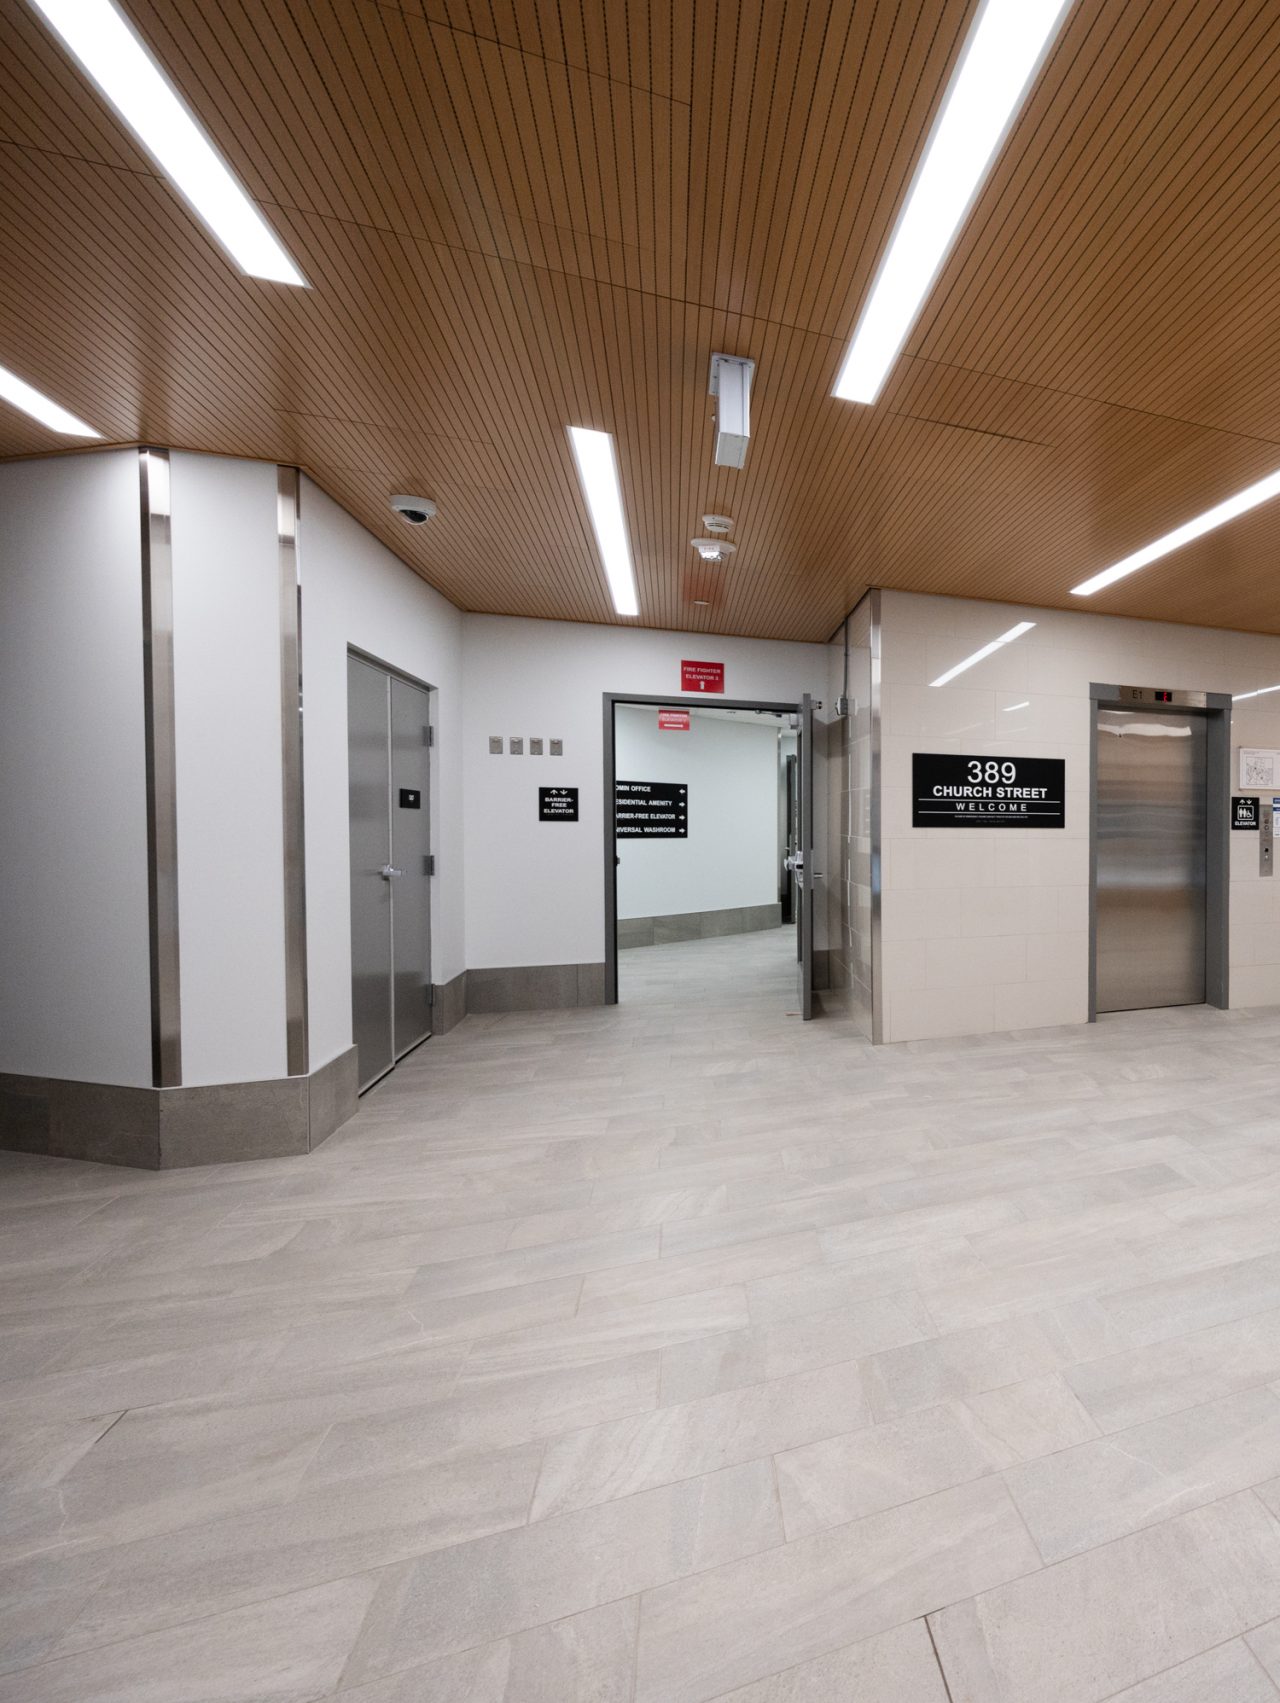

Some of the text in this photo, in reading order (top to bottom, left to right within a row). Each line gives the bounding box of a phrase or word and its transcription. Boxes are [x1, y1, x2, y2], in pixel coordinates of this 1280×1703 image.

[967, 760, 1017, 784] 389
[933, 785, 1048, 799] CHURCH STREET
[648, 799, 673, 807] AMENITY
[955, 802, 1028, 812] WELCOME
[616, 812, 649, 820] ARRIER-FREE
